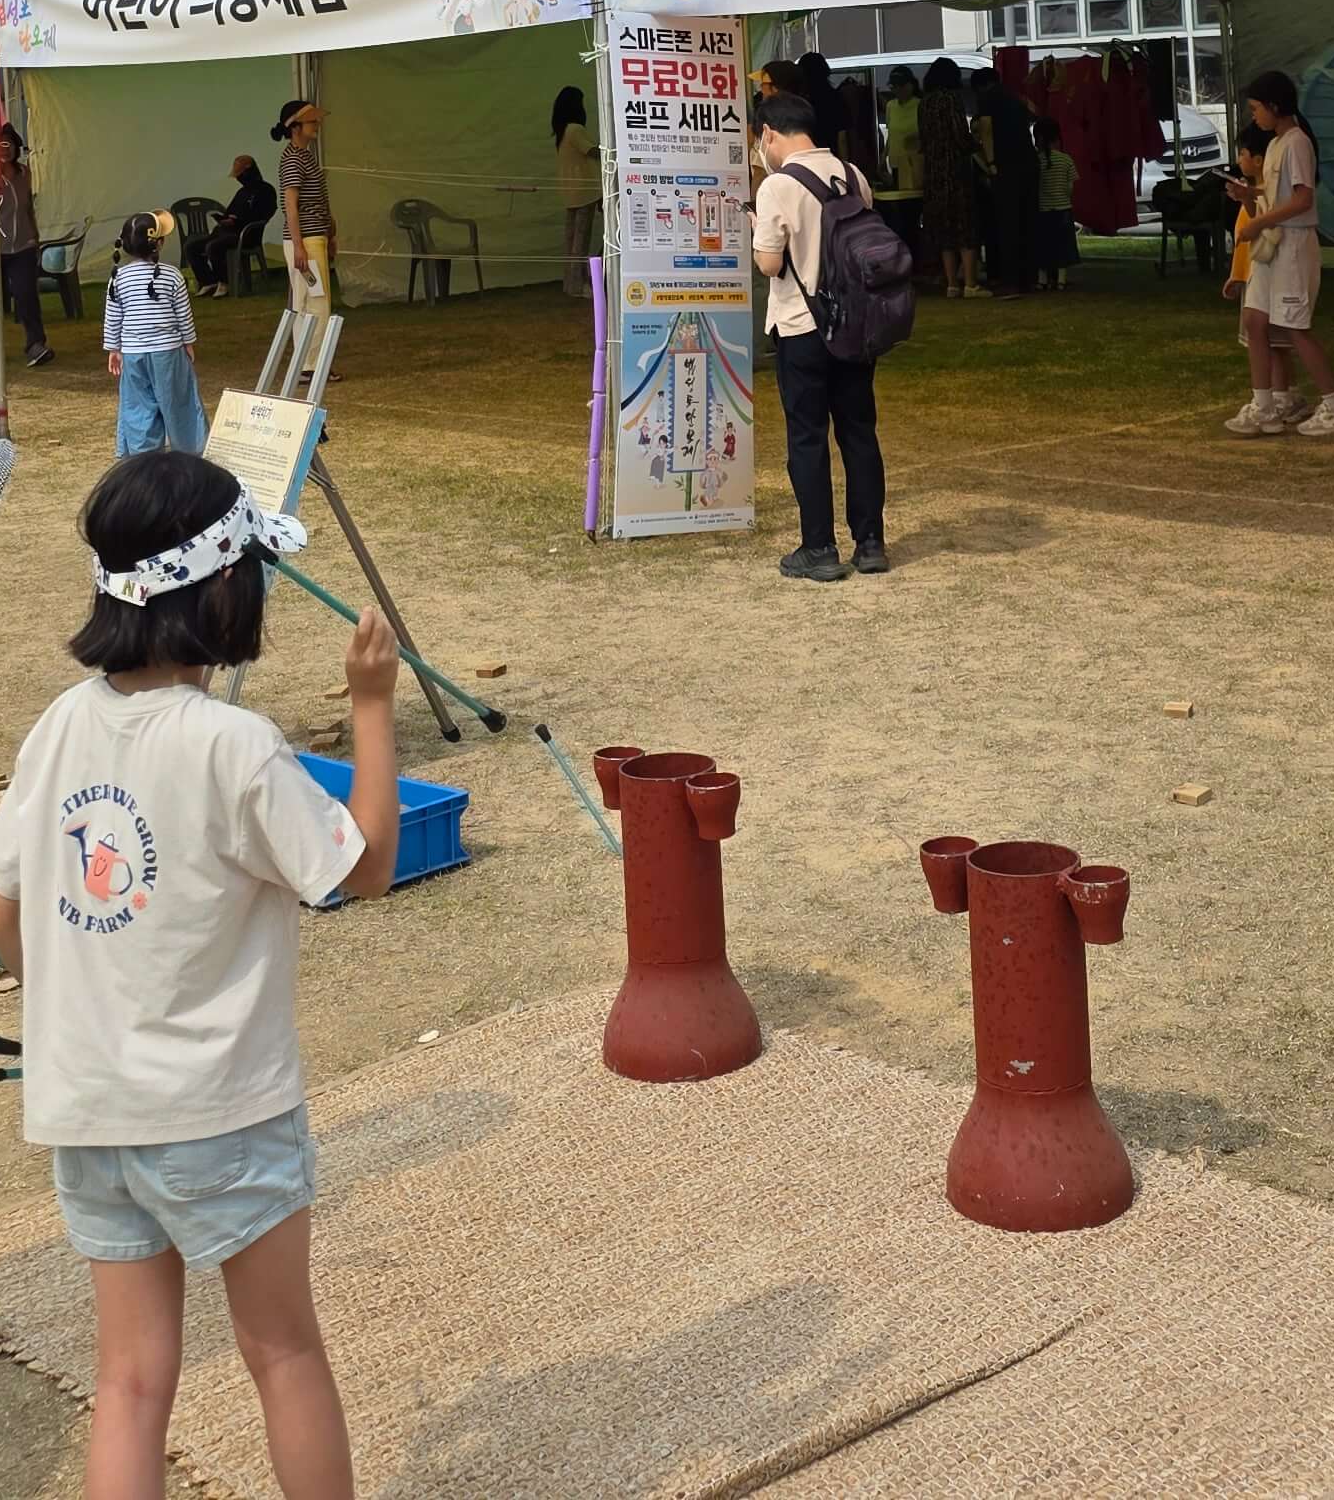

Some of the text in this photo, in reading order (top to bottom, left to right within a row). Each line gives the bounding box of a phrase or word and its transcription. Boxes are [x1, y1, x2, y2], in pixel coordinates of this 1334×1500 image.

[619, 26, 735, 56] 스마트폰 사진
[621, 57, 738, 100] 무료인화
[625, 100, 741, 133] 셀프 서비스
[134, 817, 158, 891] GROW
[84, 907, 134, 934] FARM
